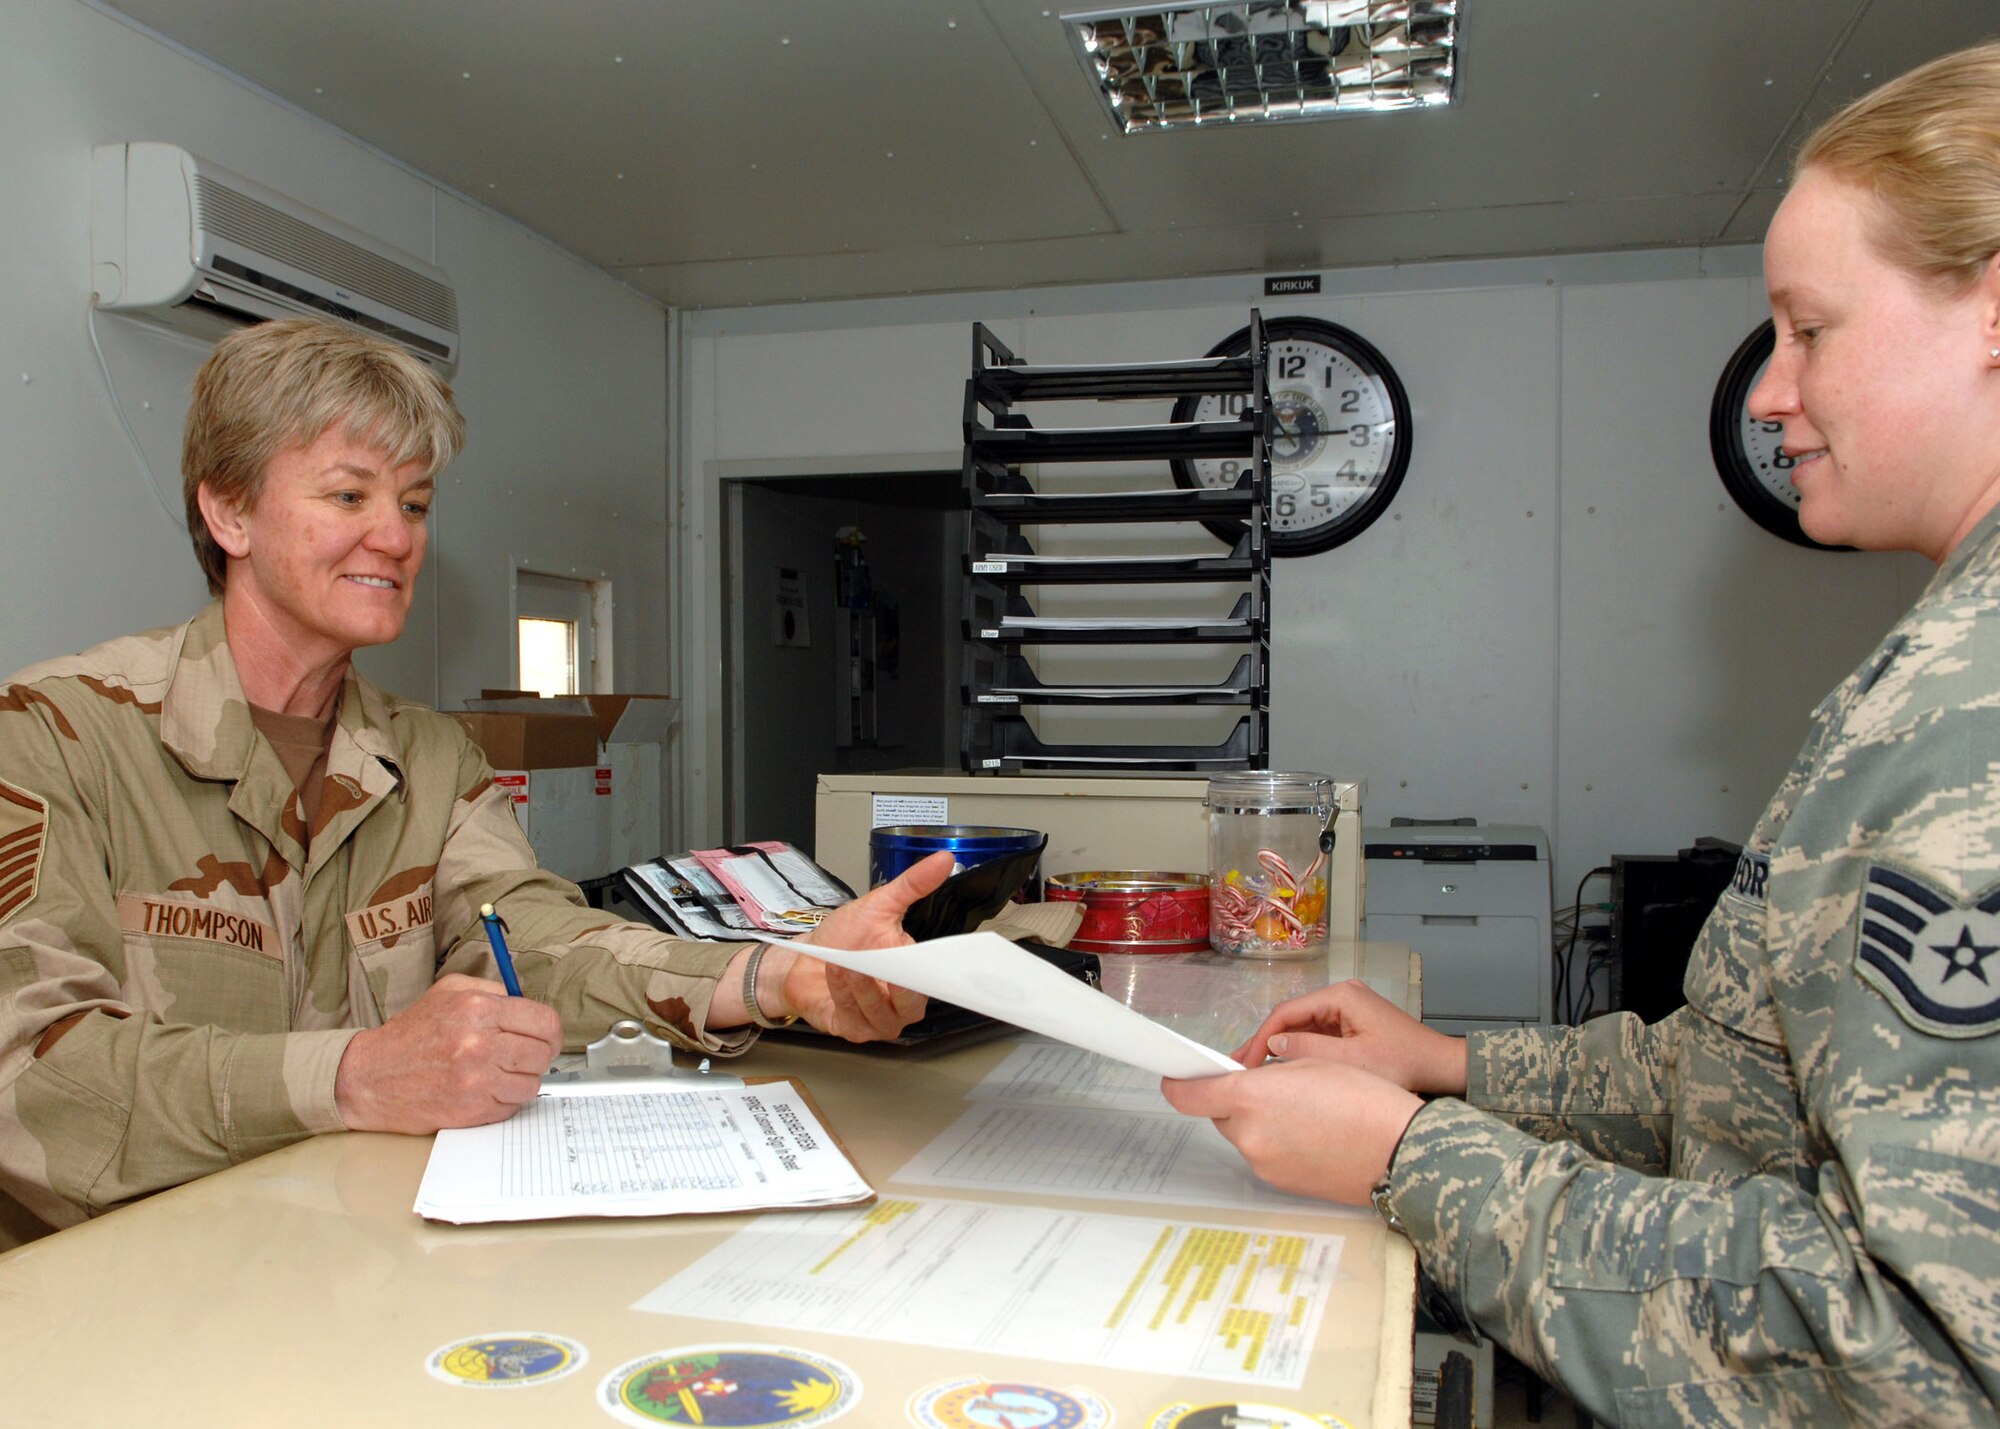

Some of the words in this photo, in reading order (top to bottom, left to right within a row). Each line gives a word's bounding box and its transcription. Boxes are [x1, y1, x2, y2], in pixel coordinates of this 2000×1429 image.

[1271, 280, 1315, 291] KIRKUK
[1279, 356, 1306, 379] 12
[1325, 366, 1332, 389] 1
[1218, 394, 1248, 416] 10
[1340, 390, 1361, 413] 2
[1349, 424, 1370, 447] 3
[1219, 460, 1240, 484] 8
[1336, 459, 1357, 481] 4
[1275, 494, 1296, 517] 6
[1310, 484, 1330, 507] 5
[143, 901, 263, 951] THOMPSON
[358, 907, 402, 939] U.S.
[406, 896, 433, 928] AIR
[754, 1113, 777, 1136] Customer
[765, 1136, 785, 1149] Sign
[779, 1154, 802, 1171] Sheet
